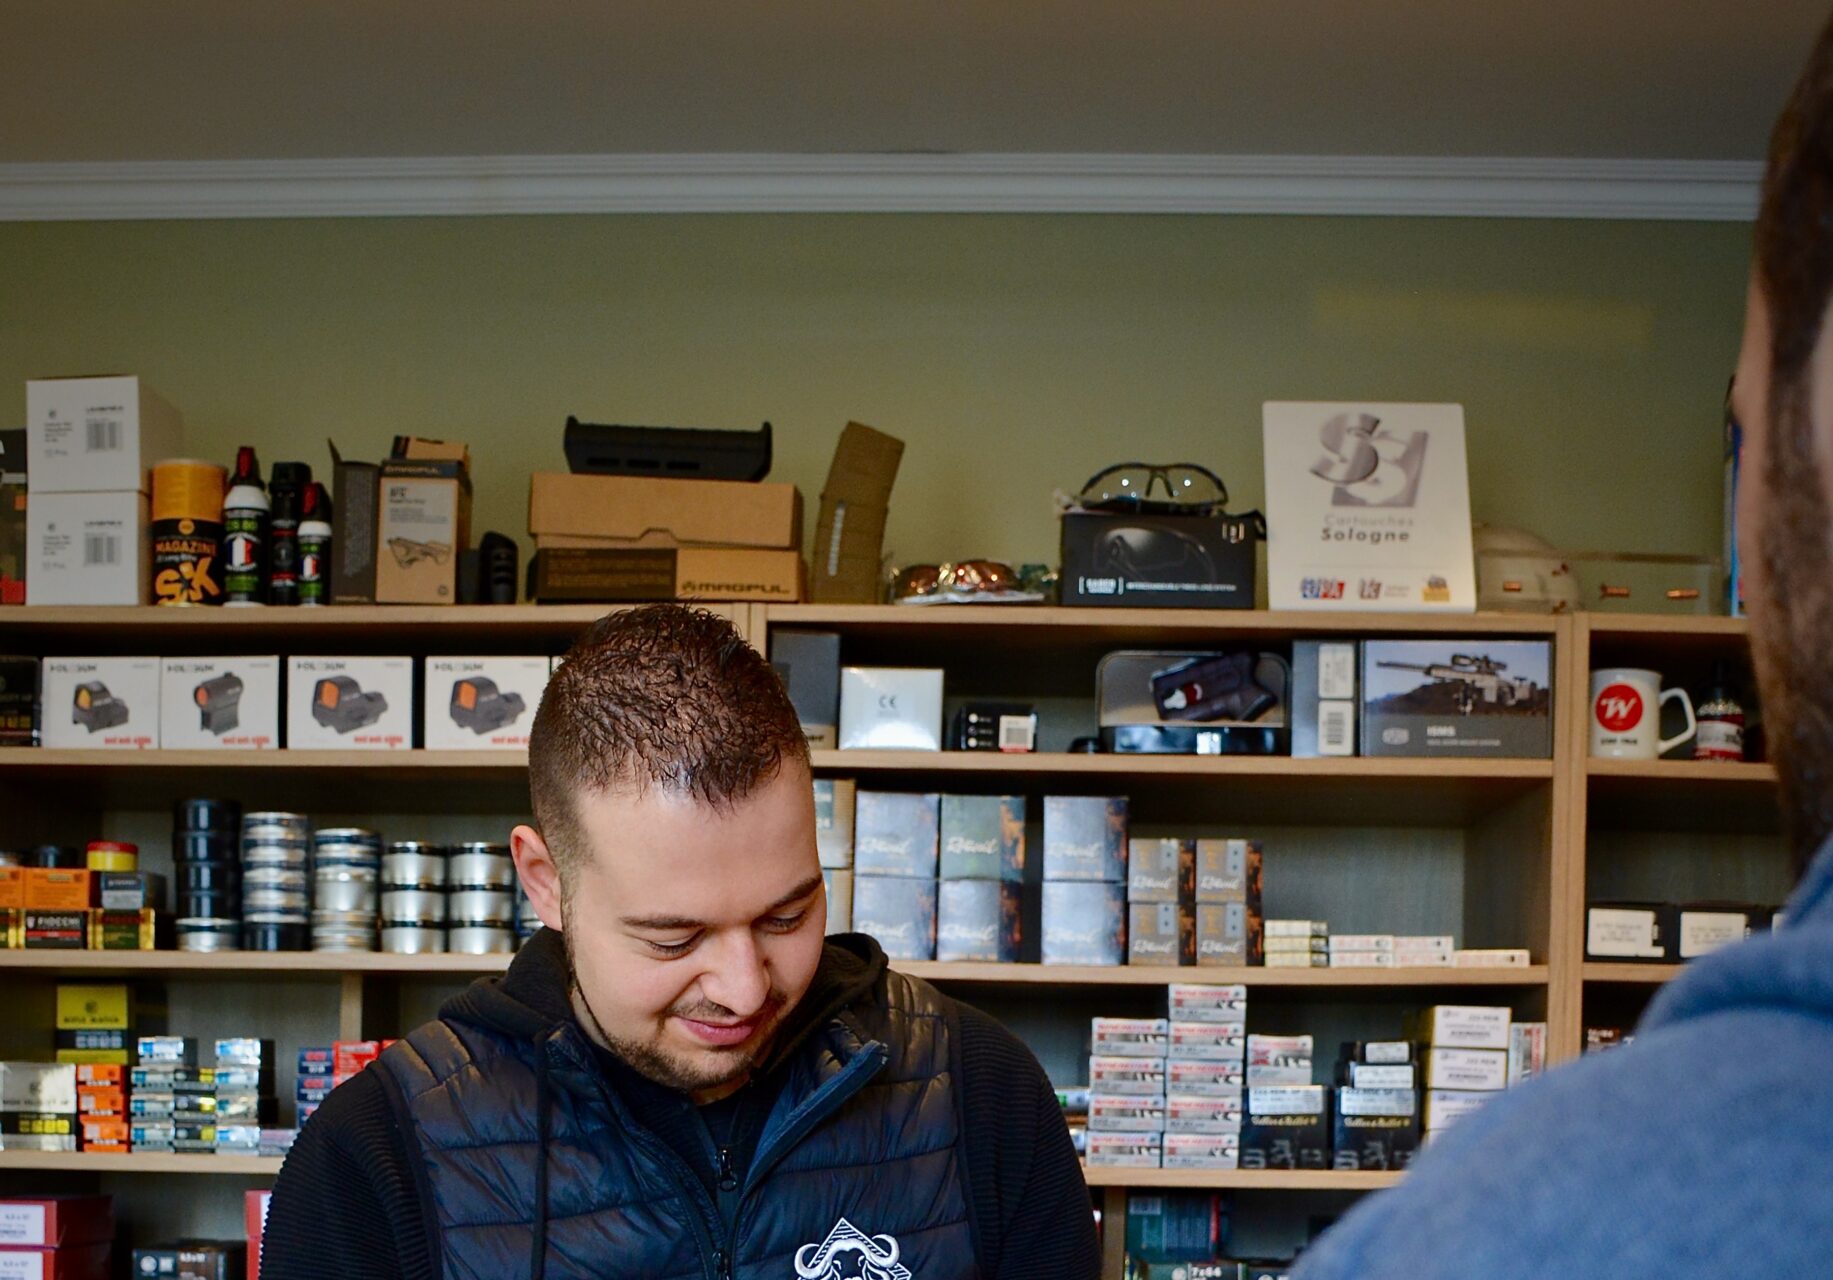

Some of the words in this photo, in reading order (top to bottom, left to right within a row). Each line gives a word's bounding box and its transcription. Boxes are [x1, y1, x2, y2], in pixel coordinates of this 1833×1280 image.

[1321, 528, 1411, 544] Sologne
[699, 583, 788, 594] MAGPUL
[37, 917, 81, 926] FIOCCHI
